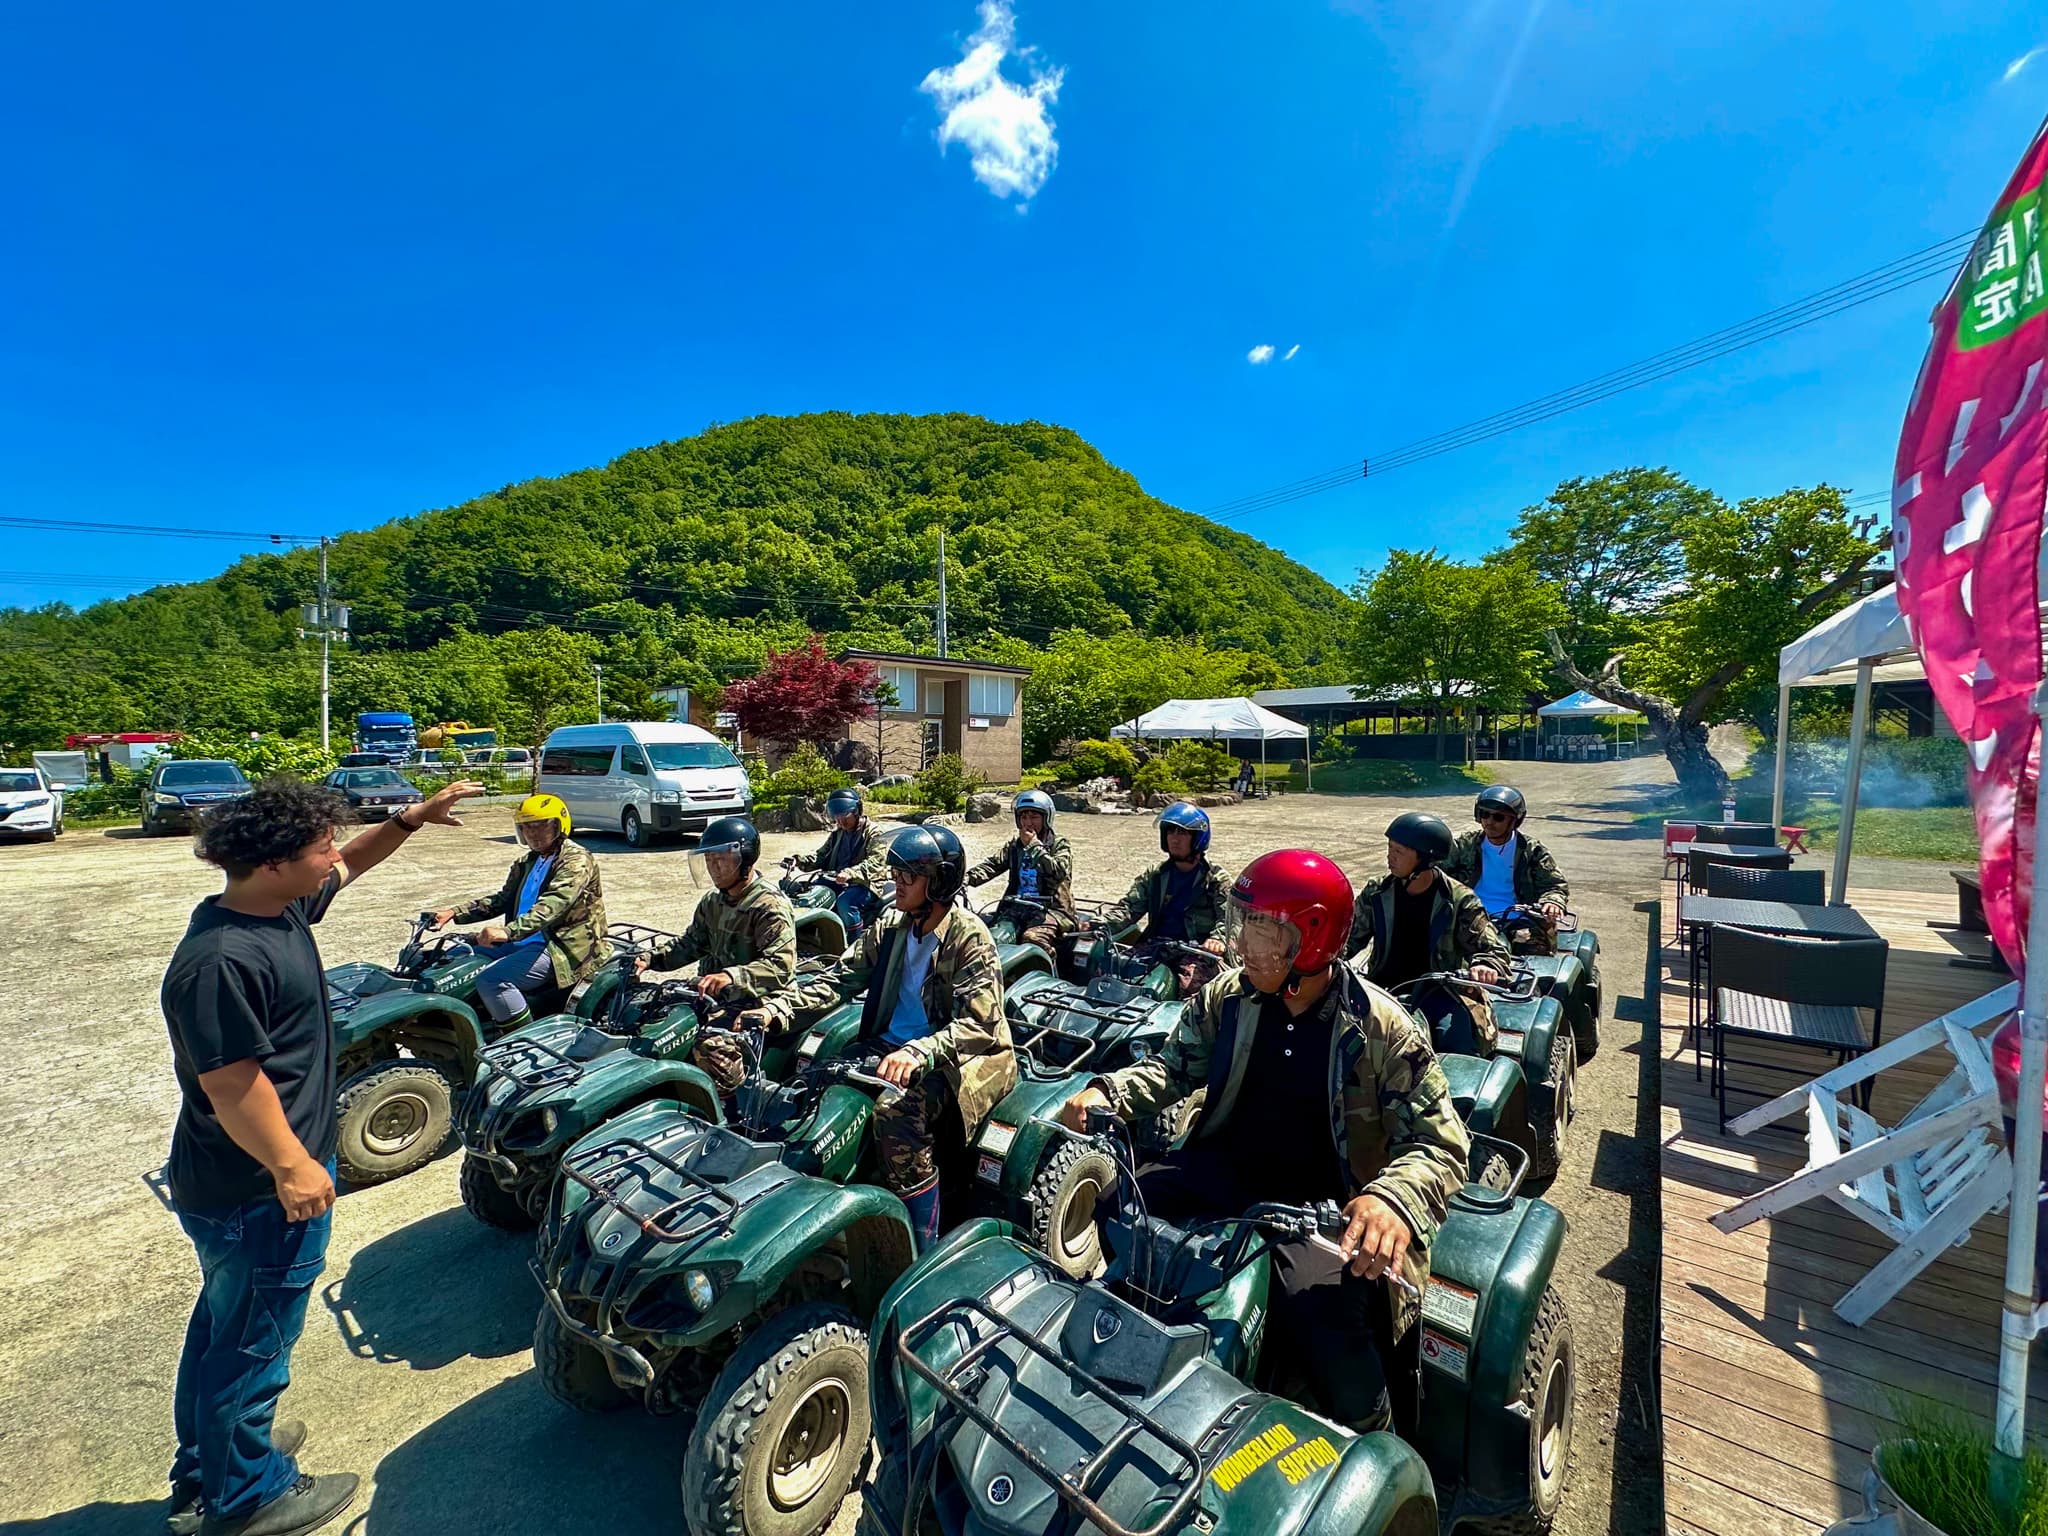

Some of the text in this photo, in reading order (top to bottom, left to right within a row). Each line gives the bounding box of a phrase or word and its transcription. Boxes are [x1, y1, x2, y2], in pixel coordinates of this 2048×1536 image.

[662, 1023, 700, 1055] GRIZZ
[812, 1130, 836, 1156] YAMAHA
[822, 1104, 867, 1165] GRIZZLY
[1240, 1303, 1262, 1345] YAMAHA
[1209, 1423, 1297, 1492] WONDERLAND
[1277, 1436, 1340, 1486] SAPPORO
